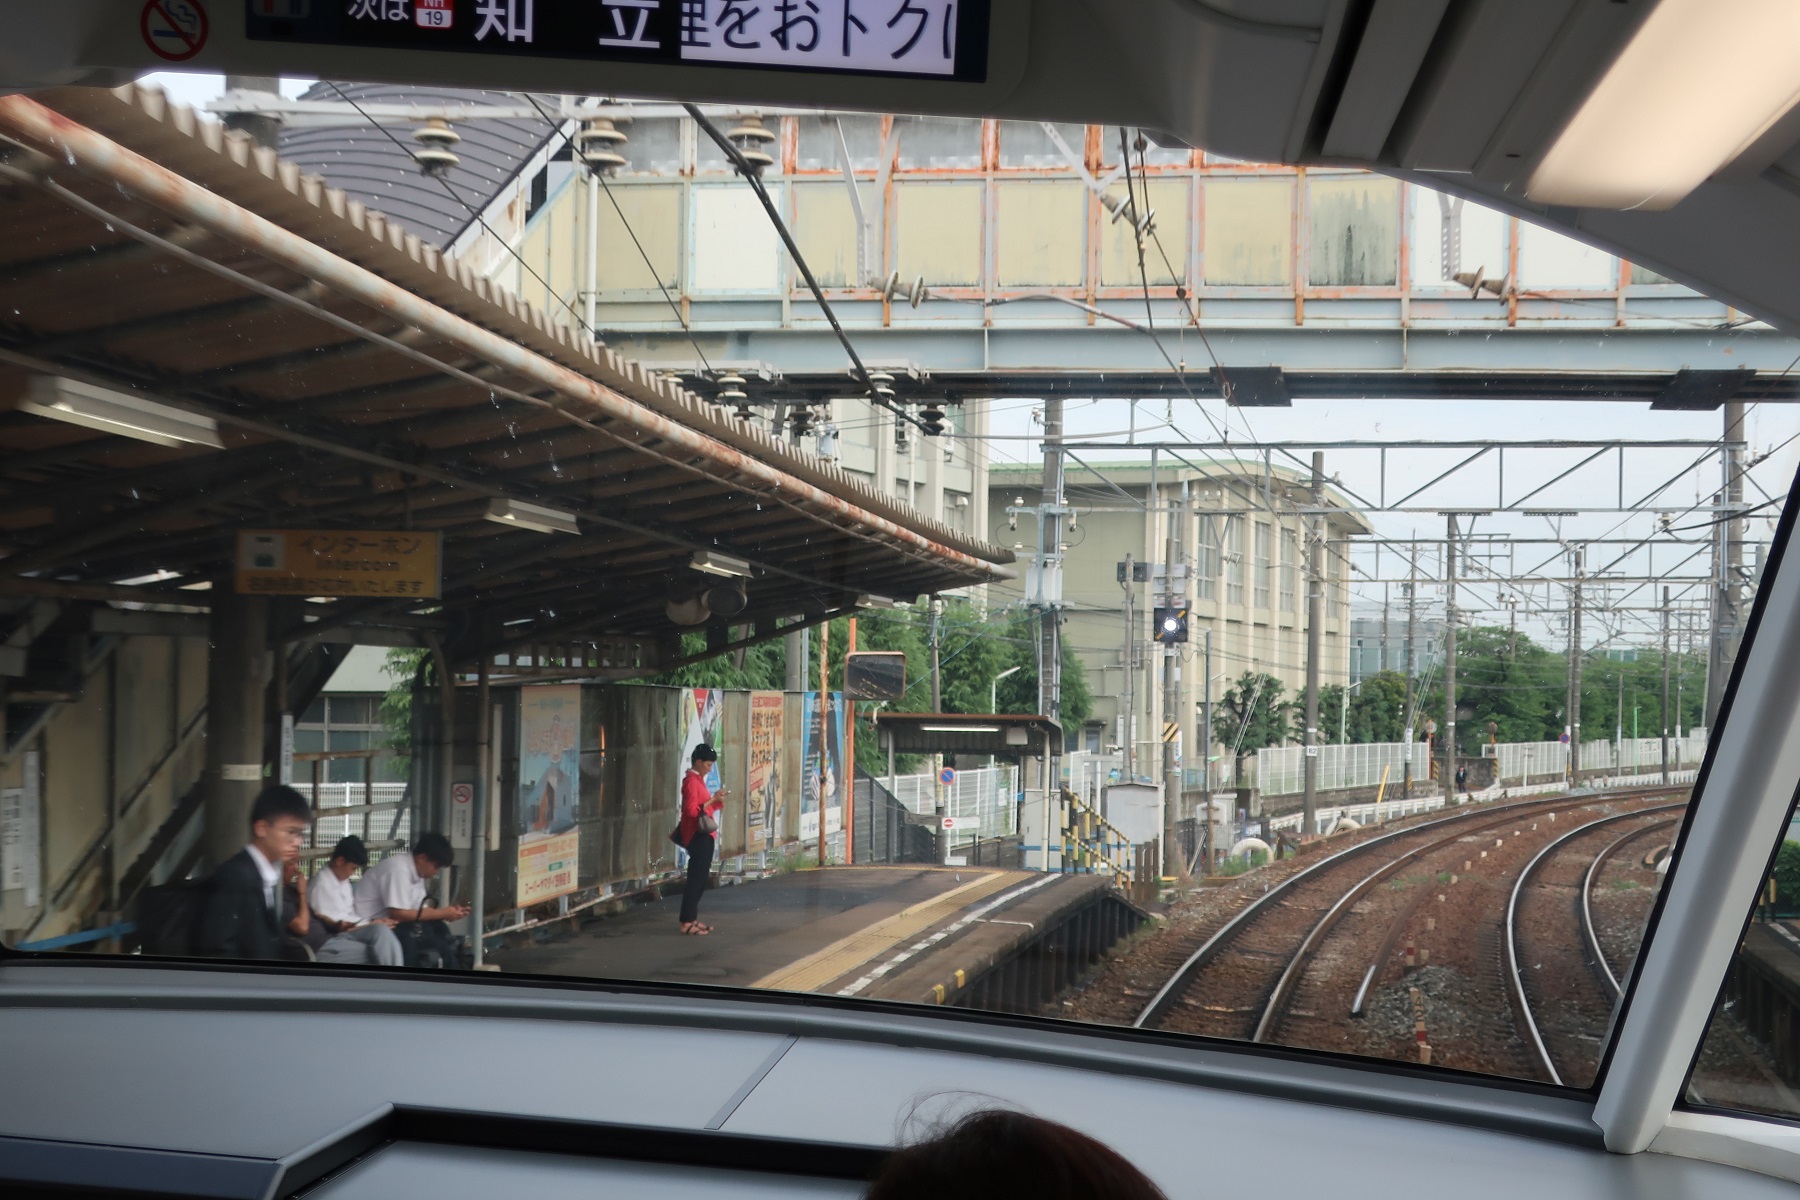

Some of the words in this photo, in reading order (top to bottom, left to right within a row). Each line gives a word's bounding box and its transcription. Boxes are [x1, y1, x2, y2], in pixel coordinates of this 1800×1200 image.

[347, 0, 409, 20] 次は
[425, 10, 443, 26] 19
[299, 534, 423, 554] インターホン
